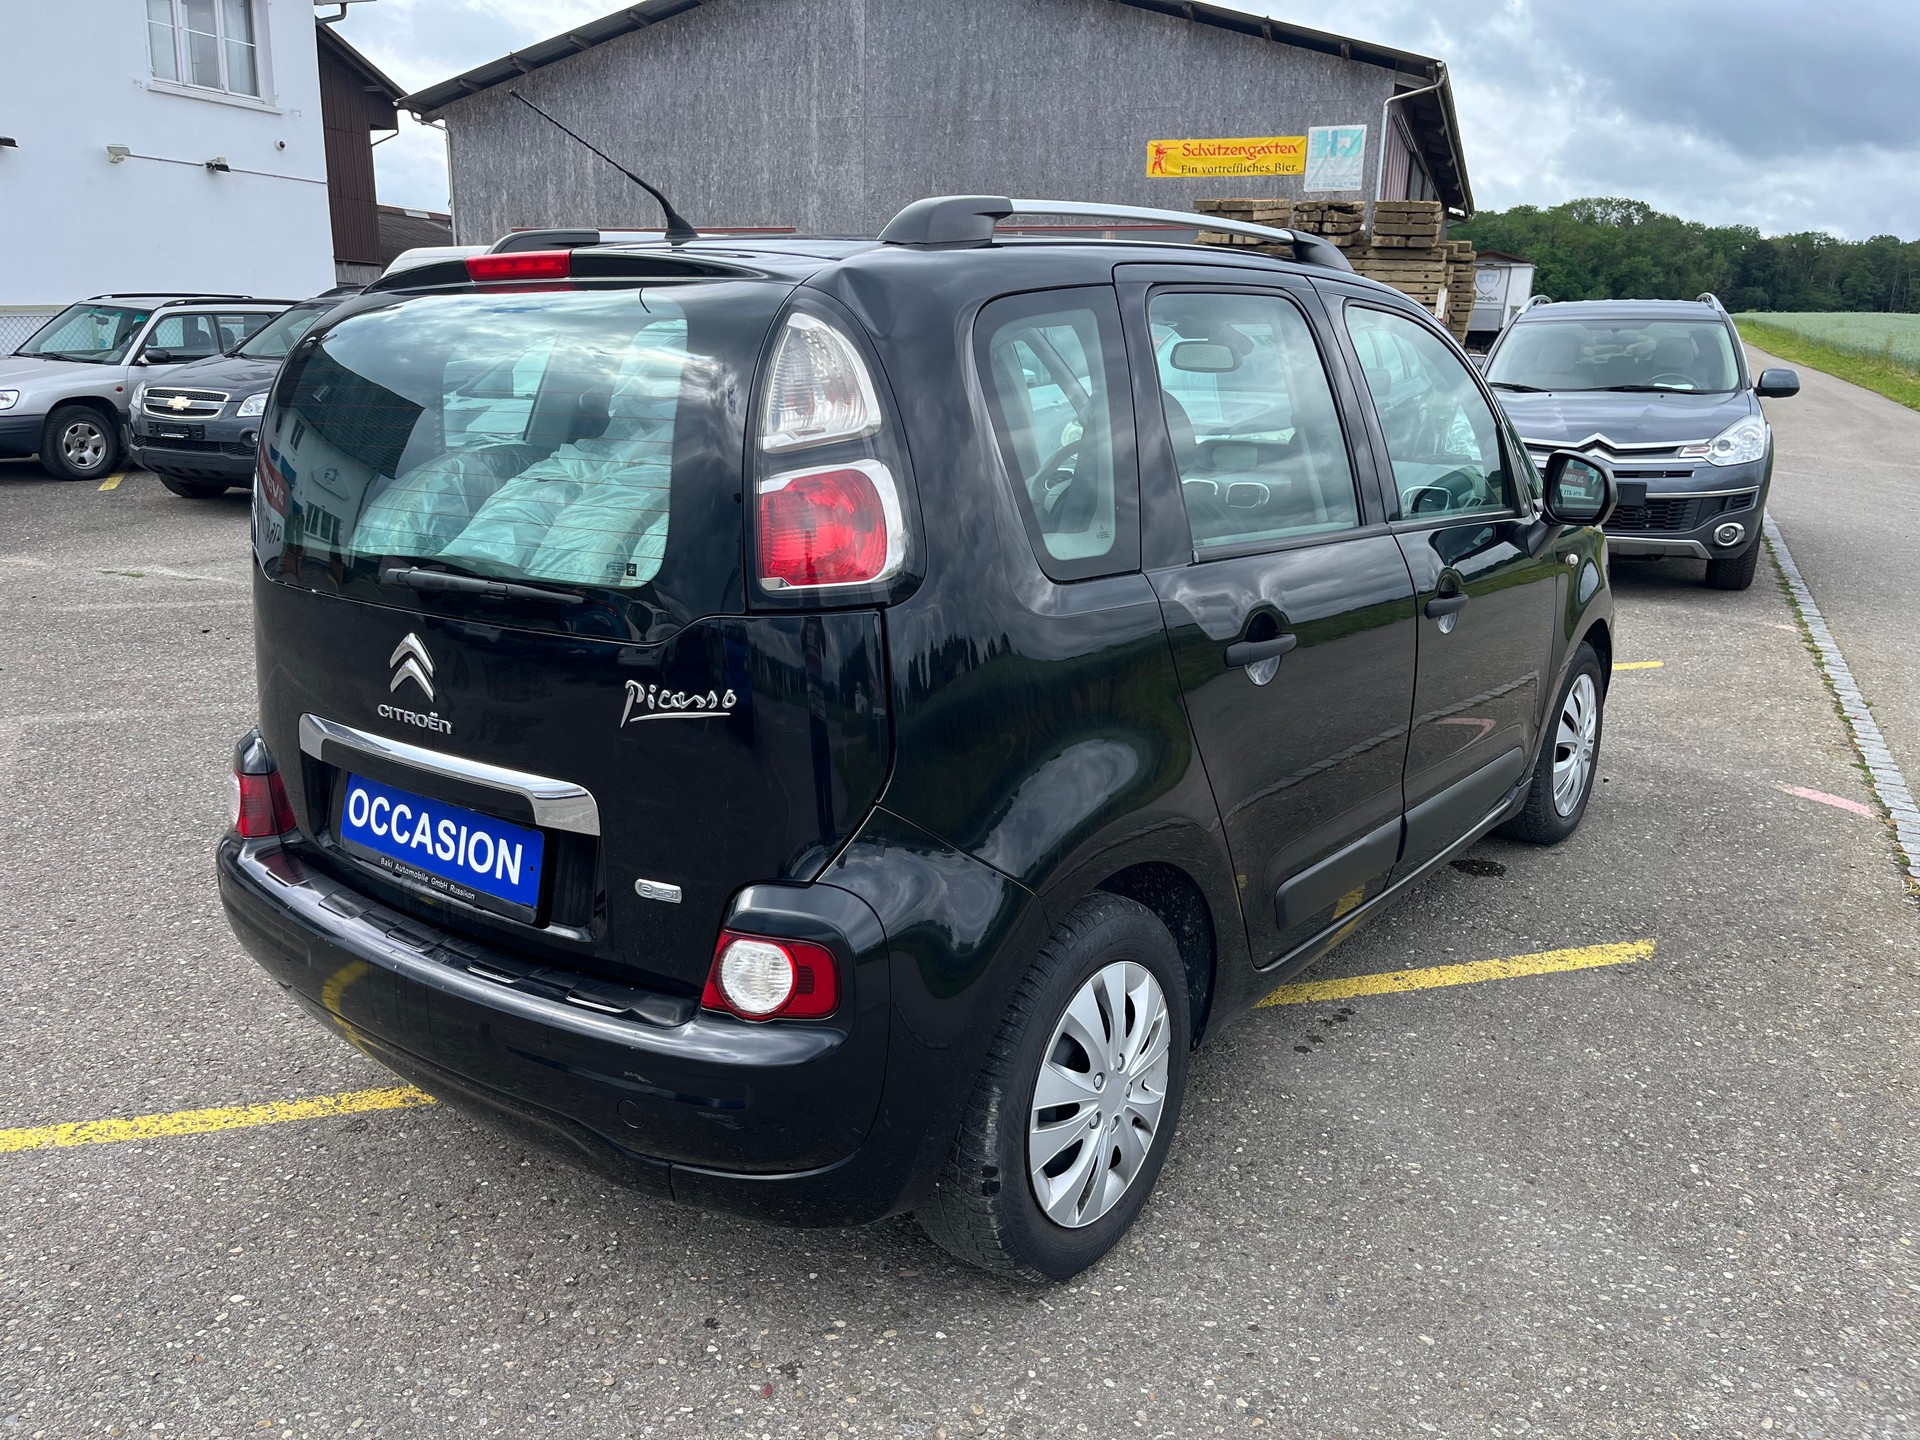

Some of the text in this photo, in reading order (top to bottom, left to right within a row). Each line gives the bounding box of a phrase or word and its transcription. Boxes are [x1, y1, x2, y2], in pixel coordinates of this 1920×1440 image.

[1182, 142, 1298, 160] Schützengarten
[1181, 165, 1198, 174] Ein
[1201, 163, 1270, 174] vortreffliches
[1274, 163, 1298, 172] Bier.
[620, 679, 738, 728] Picasso
[347, 787, 523, 886] OCCASION
[394, 863, 429, 883] Automobile
[430, 877, 449, 890] GmbH
